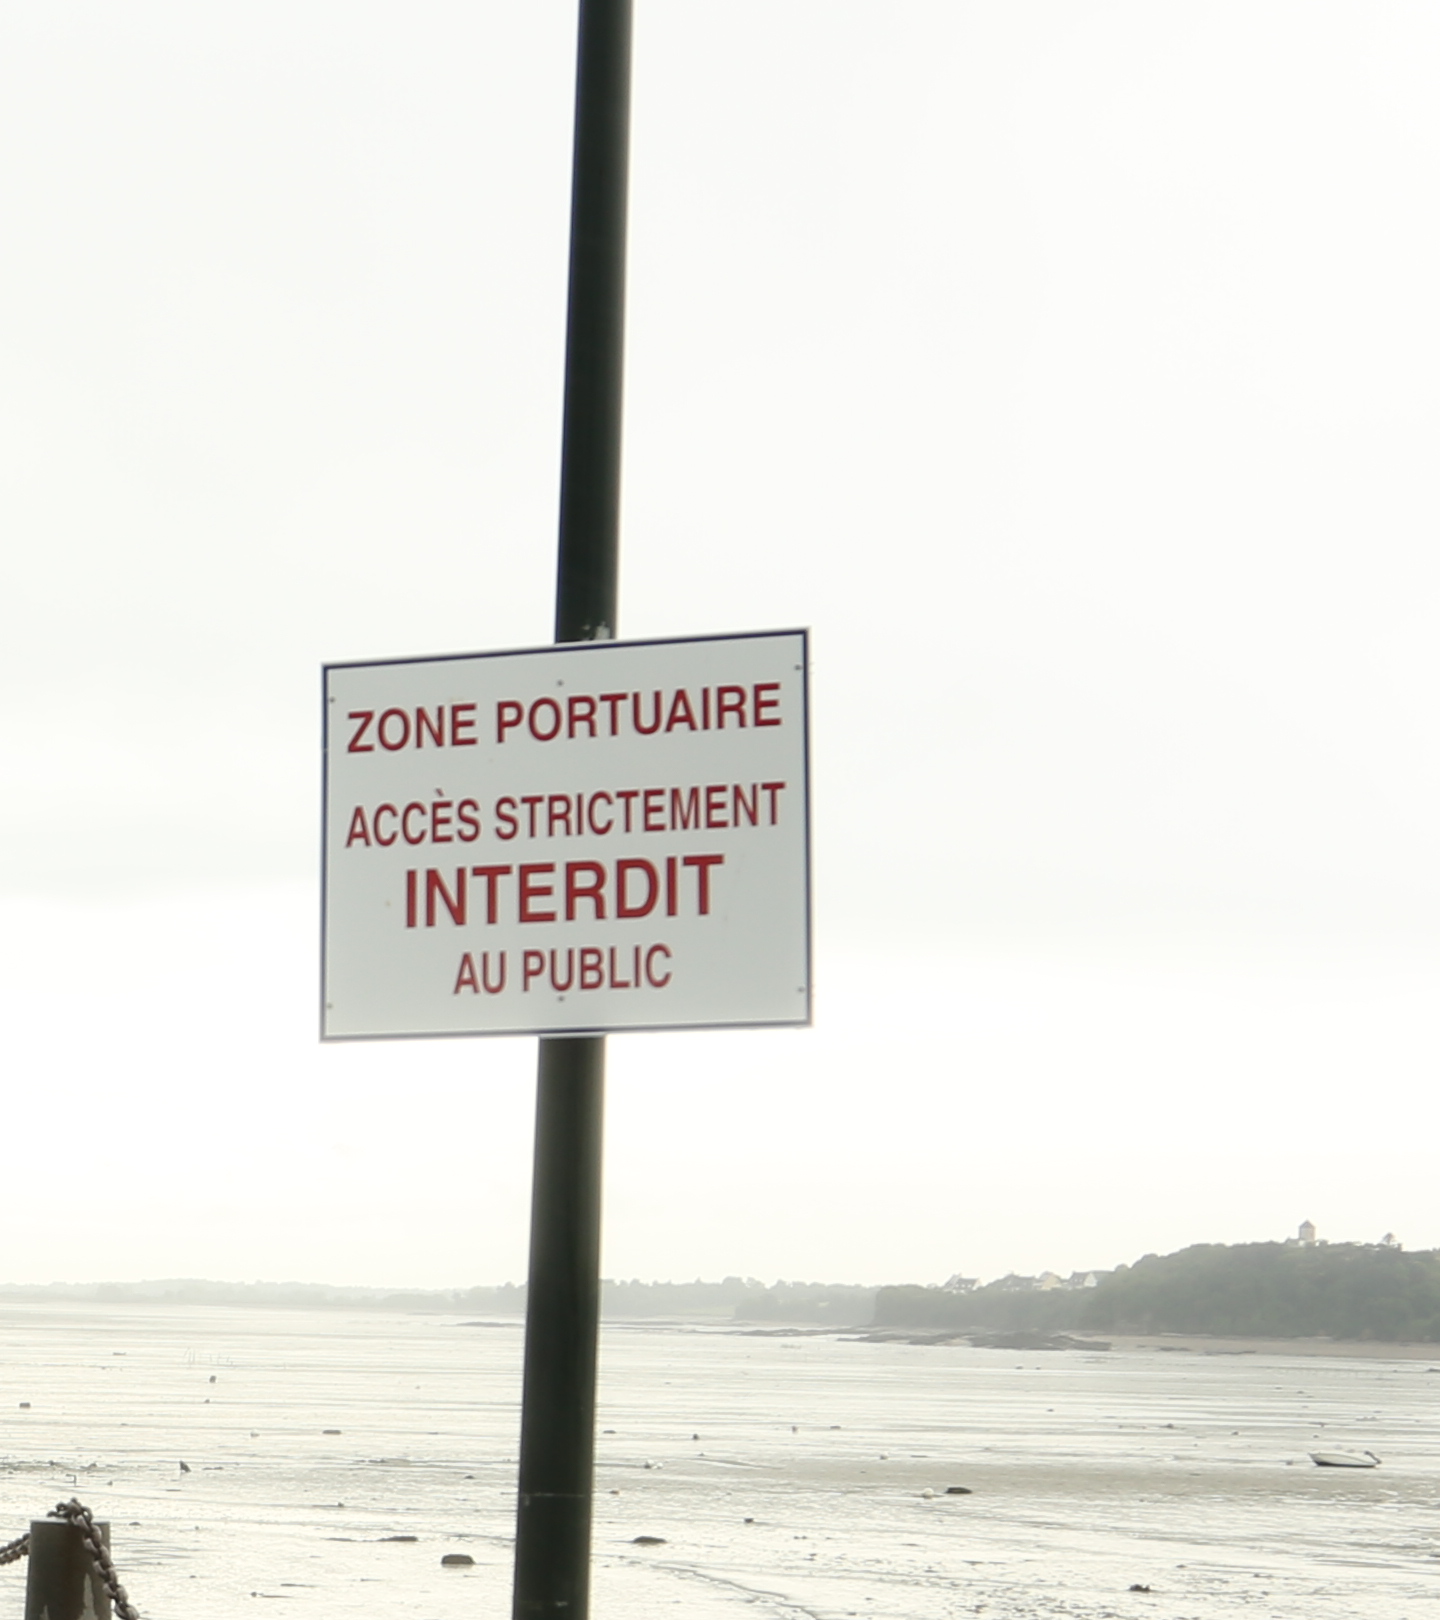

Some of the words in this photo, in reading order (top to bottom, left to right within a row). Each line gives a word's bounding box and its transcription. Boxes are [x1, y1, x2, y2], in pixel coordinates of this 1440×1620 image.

[346, 702, 478, 753] ZONE
[496, 682, 782, 743] PORTUAIRE
[345, 789, 481, 848] ACCÈS
[495, 781, 786, 840] STRICTEMENT
[405, 854, 725, 928] INTERDIT
[453, 951, 506, 995] AU
[522, 943, 672, 992] PUBLIC
